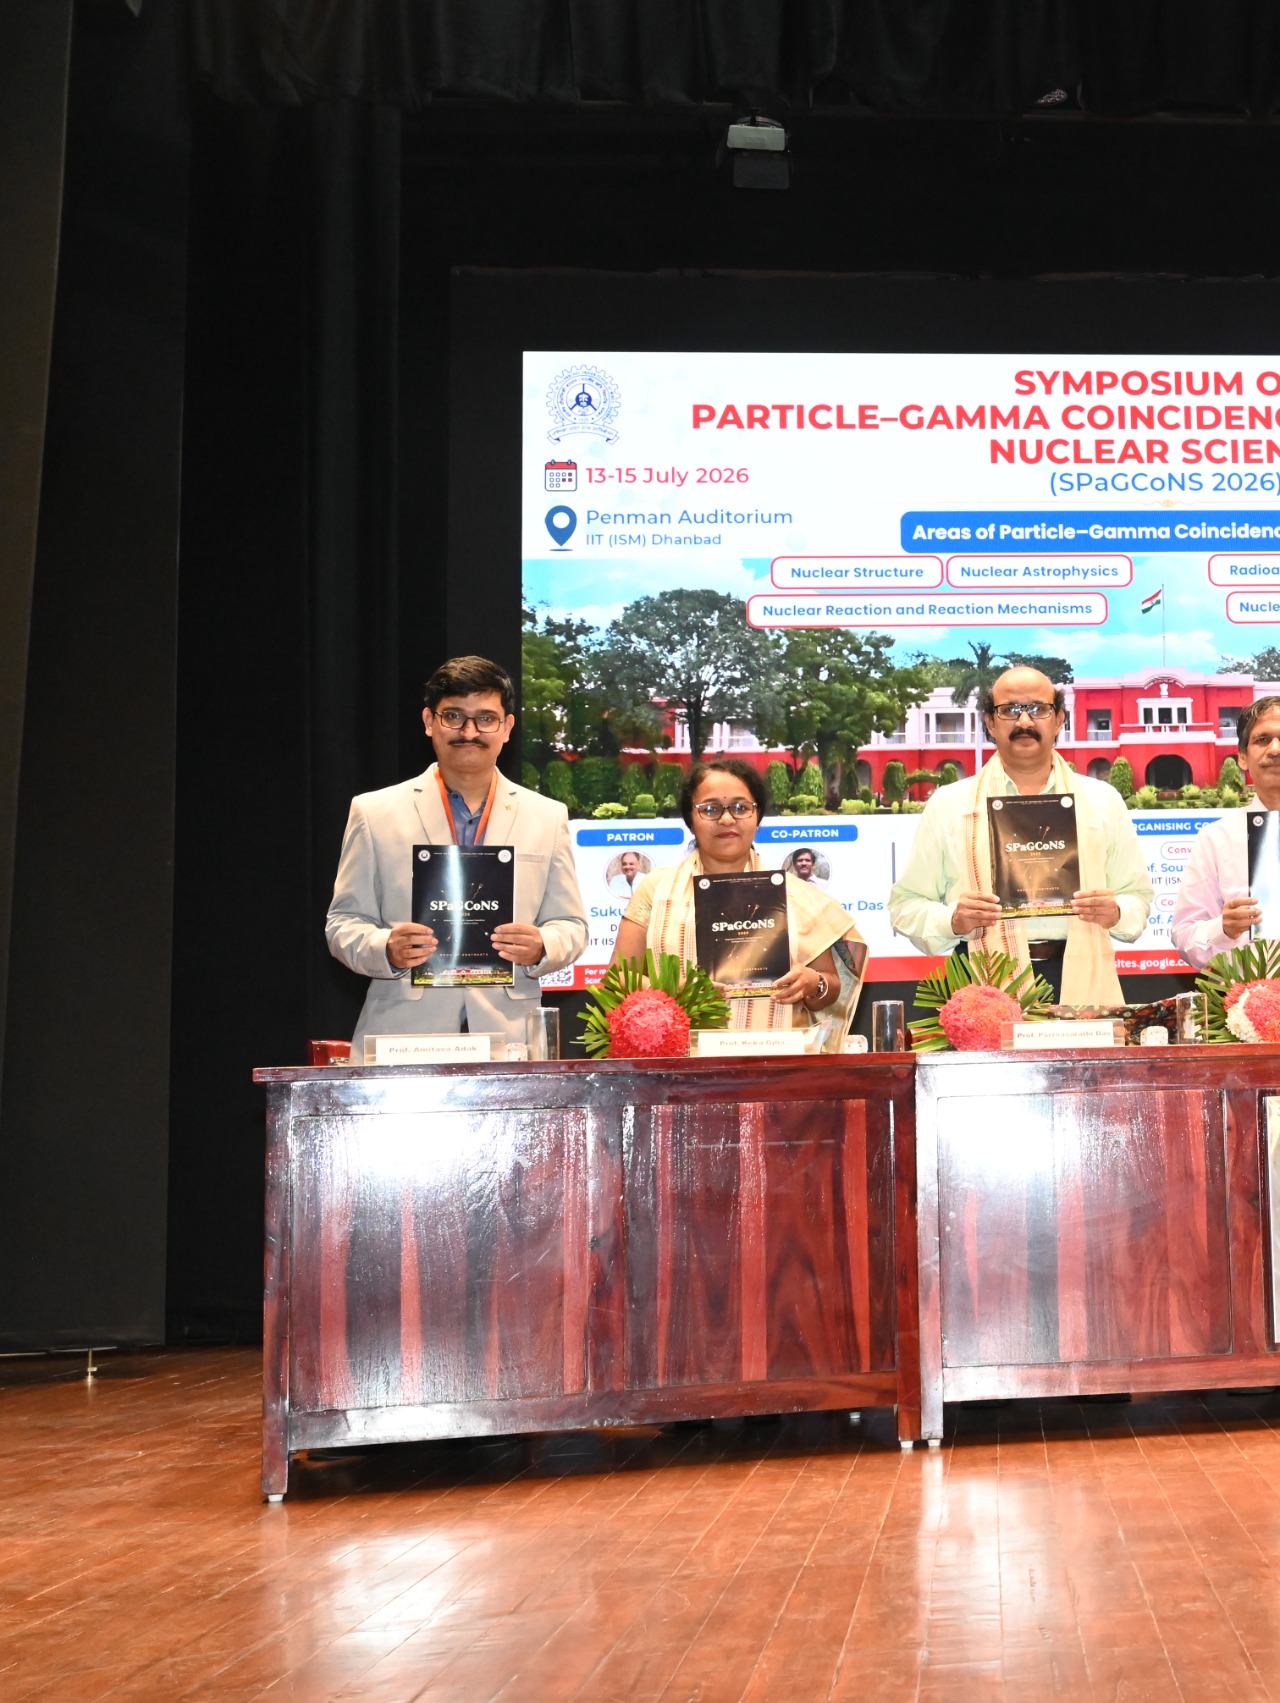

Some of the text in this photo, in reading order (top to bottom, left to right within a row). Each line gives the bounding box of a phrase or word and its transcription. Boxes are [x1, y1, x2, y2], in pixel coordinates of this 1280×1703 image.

[1014, 369, 1243, 397] SYMPOSIUM
[990, 438, 1169, 465] NUCLEAR
[585, 466, 749, 488] 13-15 July 2026
[1050, 471, 1204, 497] (SPaGCoNS
[586, 509, 793, 525] Penman Auditorium
[912, 524, 972, 540] Areas
[975, 523, 996, 540] of
[586, 533, 722, 548] IIT (ISM) Dhanbad
[791, 567, 924, 578] Nuclear Structure
[960, 565, 1119, 580] Nuclear Astrophysics
[763, 602, 1093, 617] Nuclear Reaction and Reaction Mechanisms
[606, 832, 654, 842] PATRON
[771, 828, 839, 838] CO-PATRON
[1005, 840, 1066, 852] SPaGCoNS
[1161, 863, 1185, 872] Sou
[857, 899, 884, 911] Das
[712, 918, 775, 932] SPaGCoNS
[589, 938, 599, 946] IT
